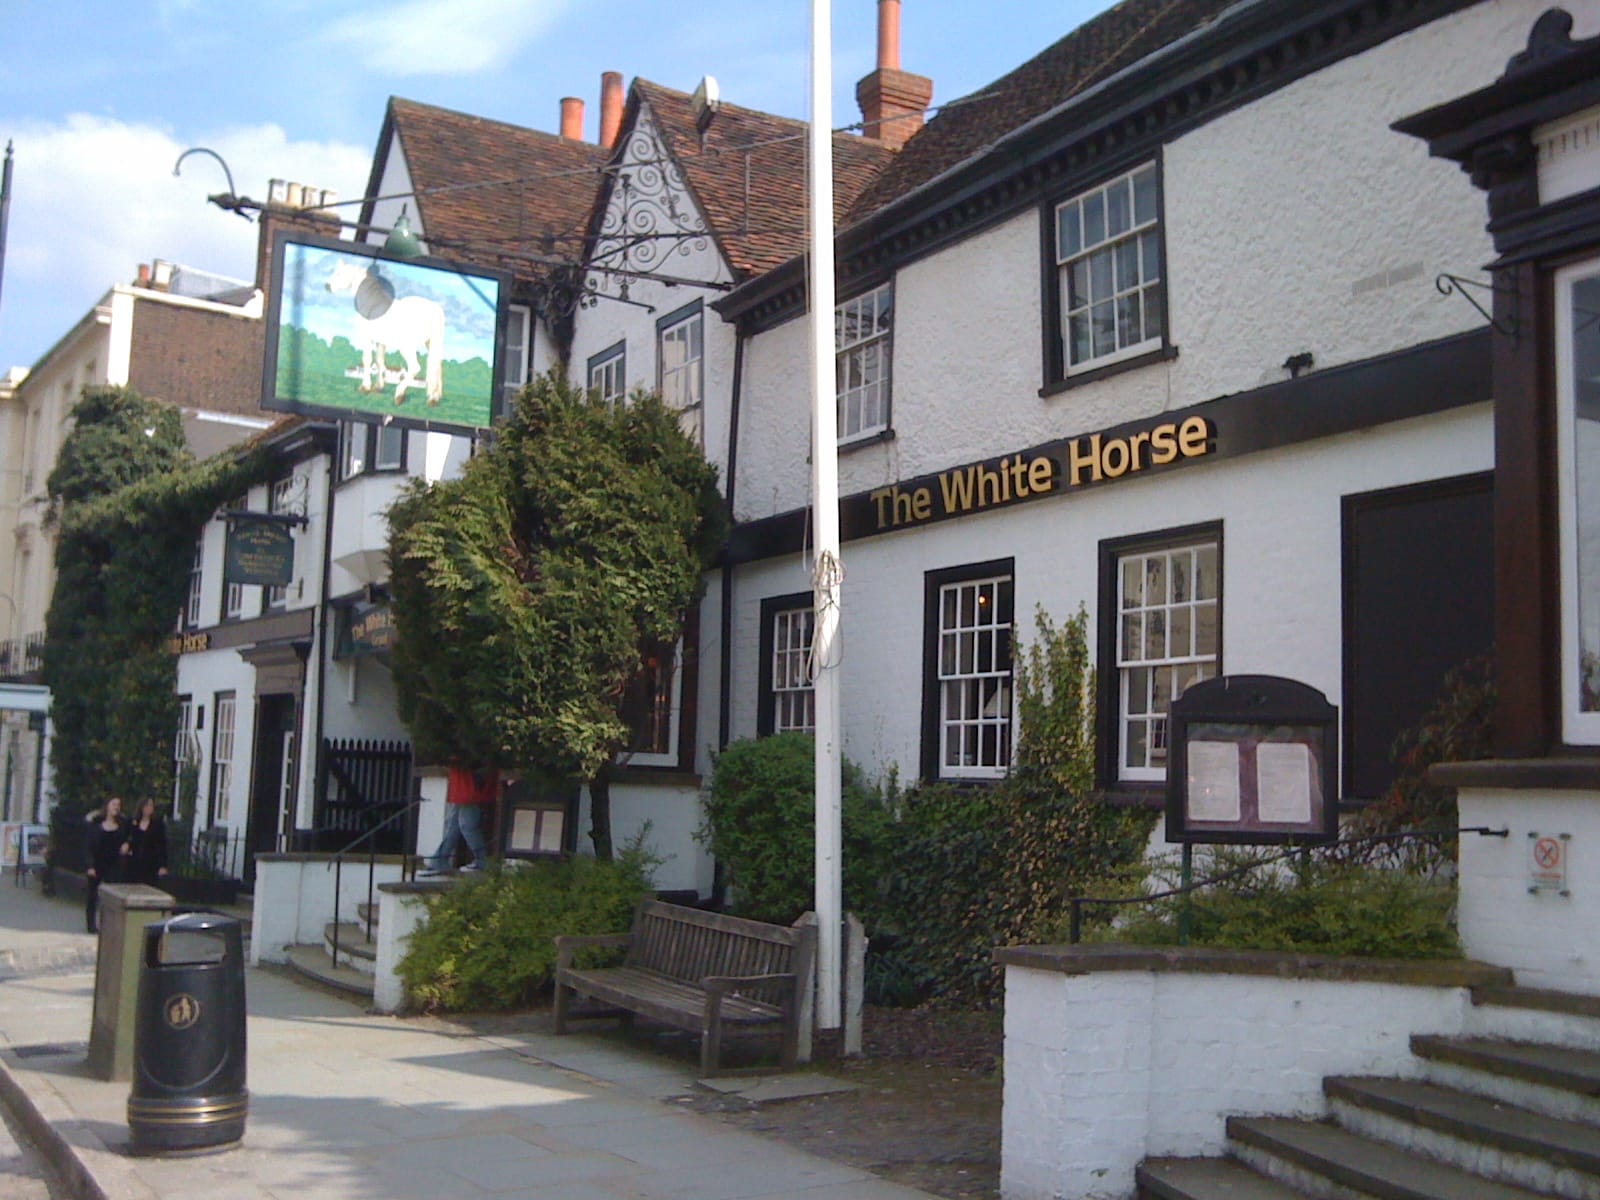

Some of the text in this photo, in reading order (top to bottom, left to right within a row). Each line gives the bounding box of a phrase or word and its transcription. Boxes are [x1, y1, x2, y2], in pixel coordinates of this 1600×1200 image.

[871, 415, 1207, 529] The White Horse
[183, 632, 208, 654] Horse
